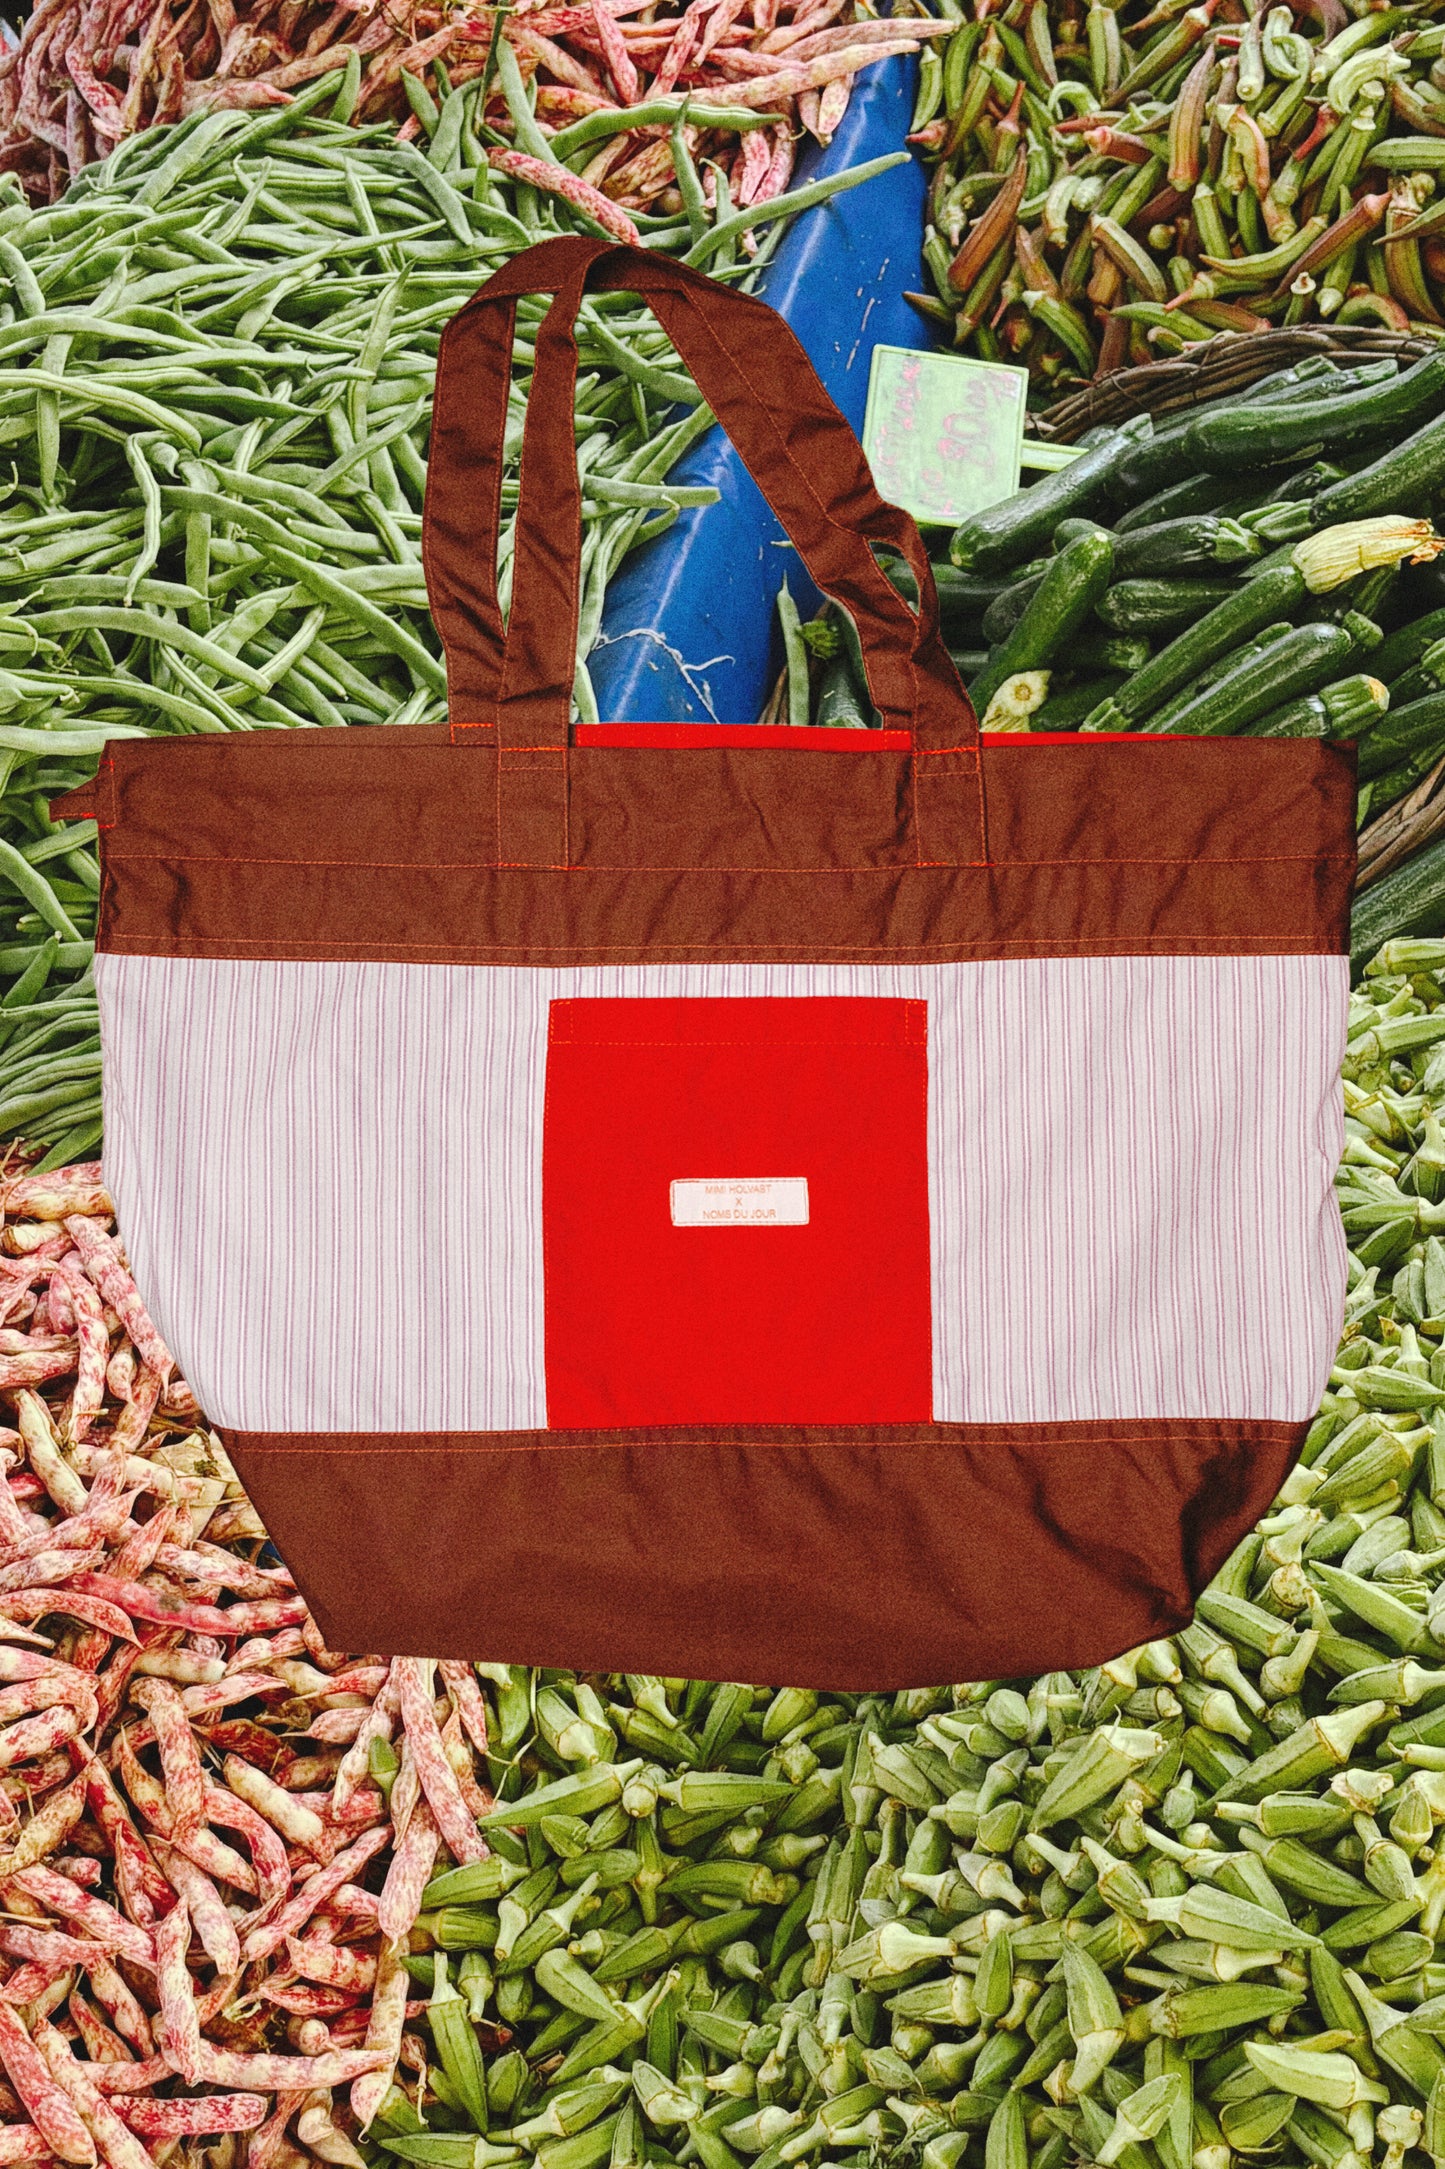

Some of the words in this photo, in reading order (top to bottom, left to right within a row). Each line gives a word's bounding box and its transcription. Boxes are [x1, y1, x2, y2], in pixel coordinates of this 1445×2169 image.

[704, 1184, 726, 1194] MIMI
[729, 1184, 772, 1194] HOLVAST
[735, 1197, 743, 1206] X
[702, 1210, 731, 1219] NOMS
[733, 1210, 748, 1219] DU
[750, 1209, 777, 1218] JOUR
